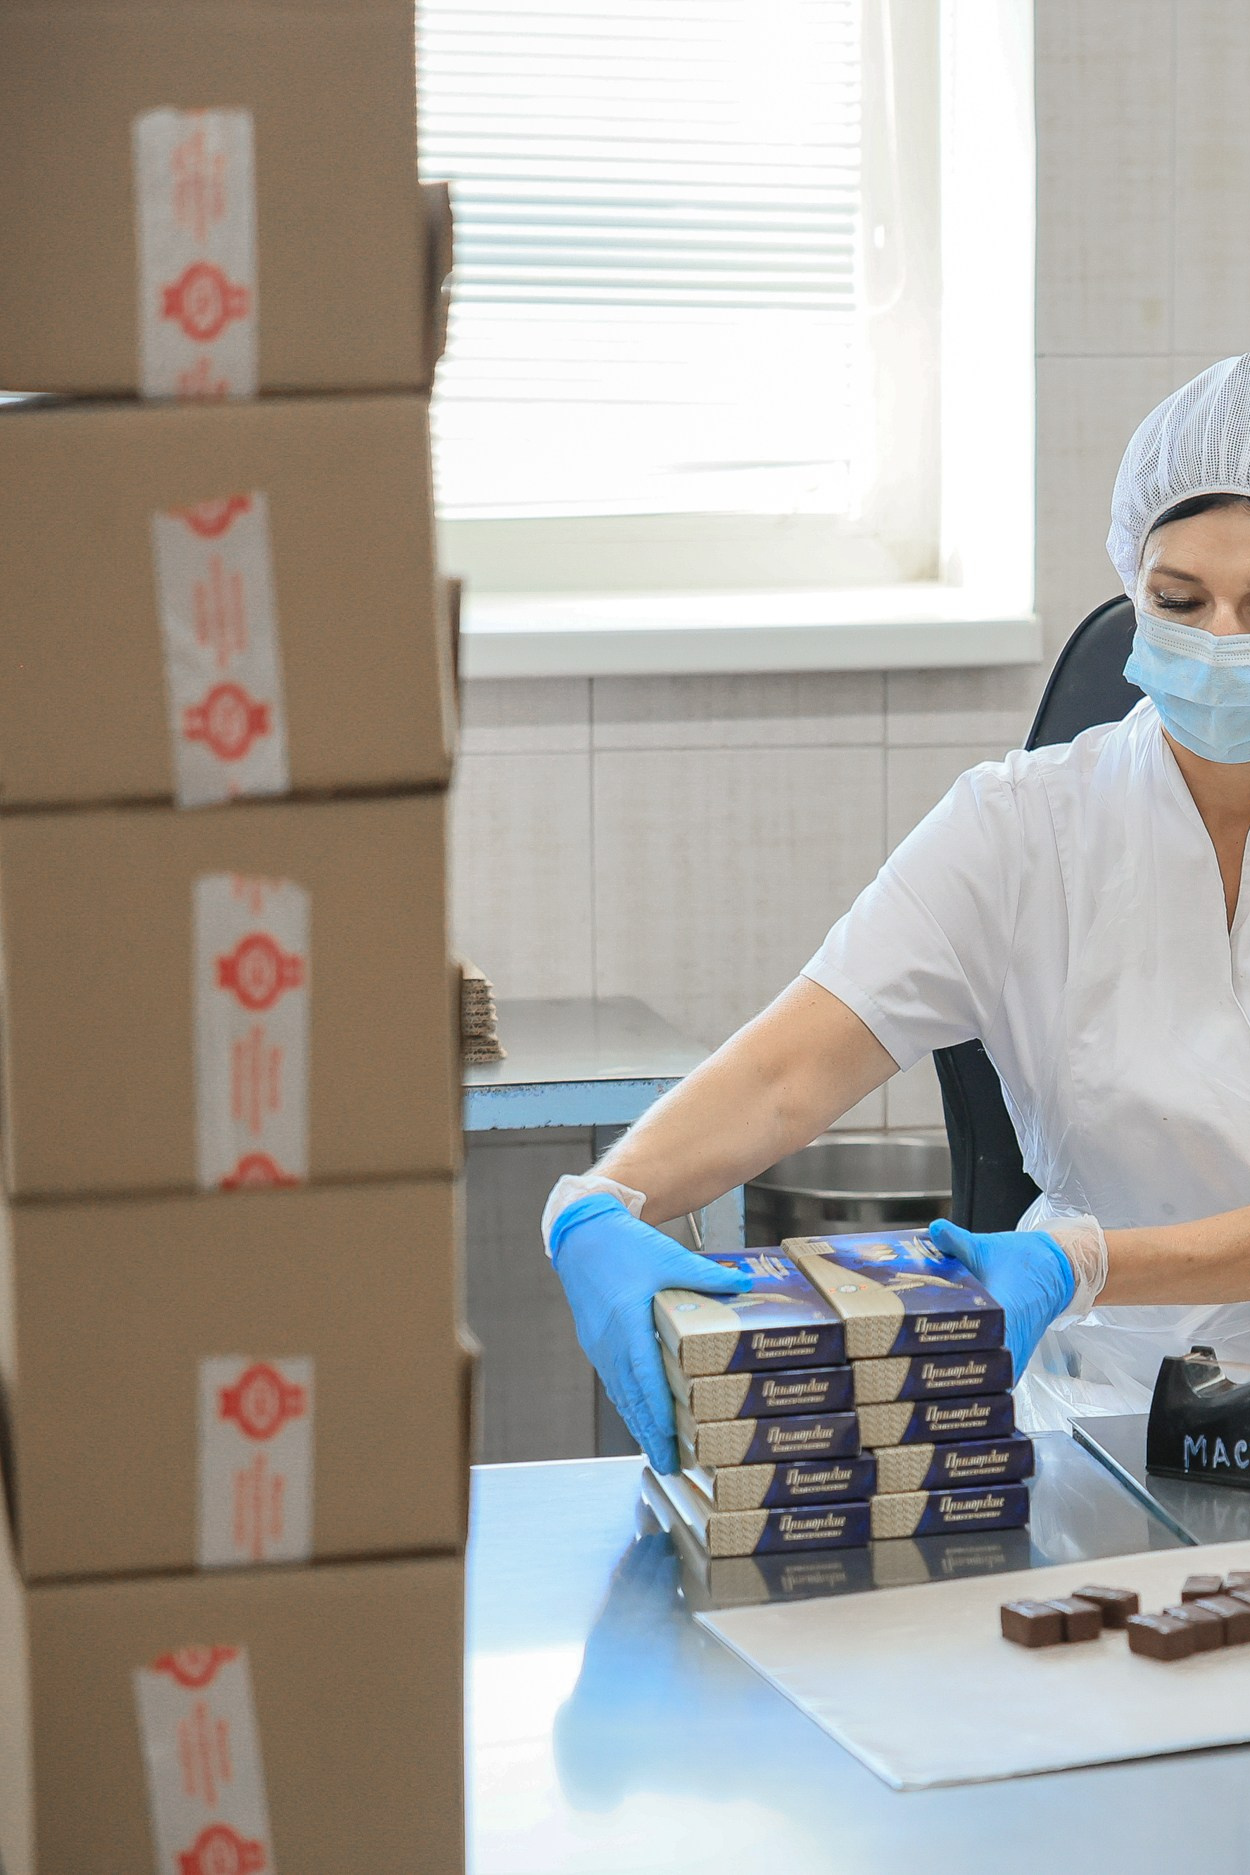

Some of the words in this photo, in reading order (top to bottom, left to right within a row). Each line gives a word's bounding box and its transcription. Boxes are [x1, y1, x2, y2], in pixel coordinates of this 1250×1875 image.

[915, 1315, 980, 1335] Приморские
[751, 1330, 819, 1350] Приморские
[921, 1361, 987, 1381] Приморские
[762, 1378, 829, 1398] Приморские
[925, 1403, 991, 1423] Приморские
[767, 1425, 834, 1444] Приморские
[945, 1449, 1010, 1470] Приморские
[786, 1466, 852, 1486] Приморские
[939, 1494, 1005, 1513] Приморские
[779, 1513, 846, 1532] Приморские
